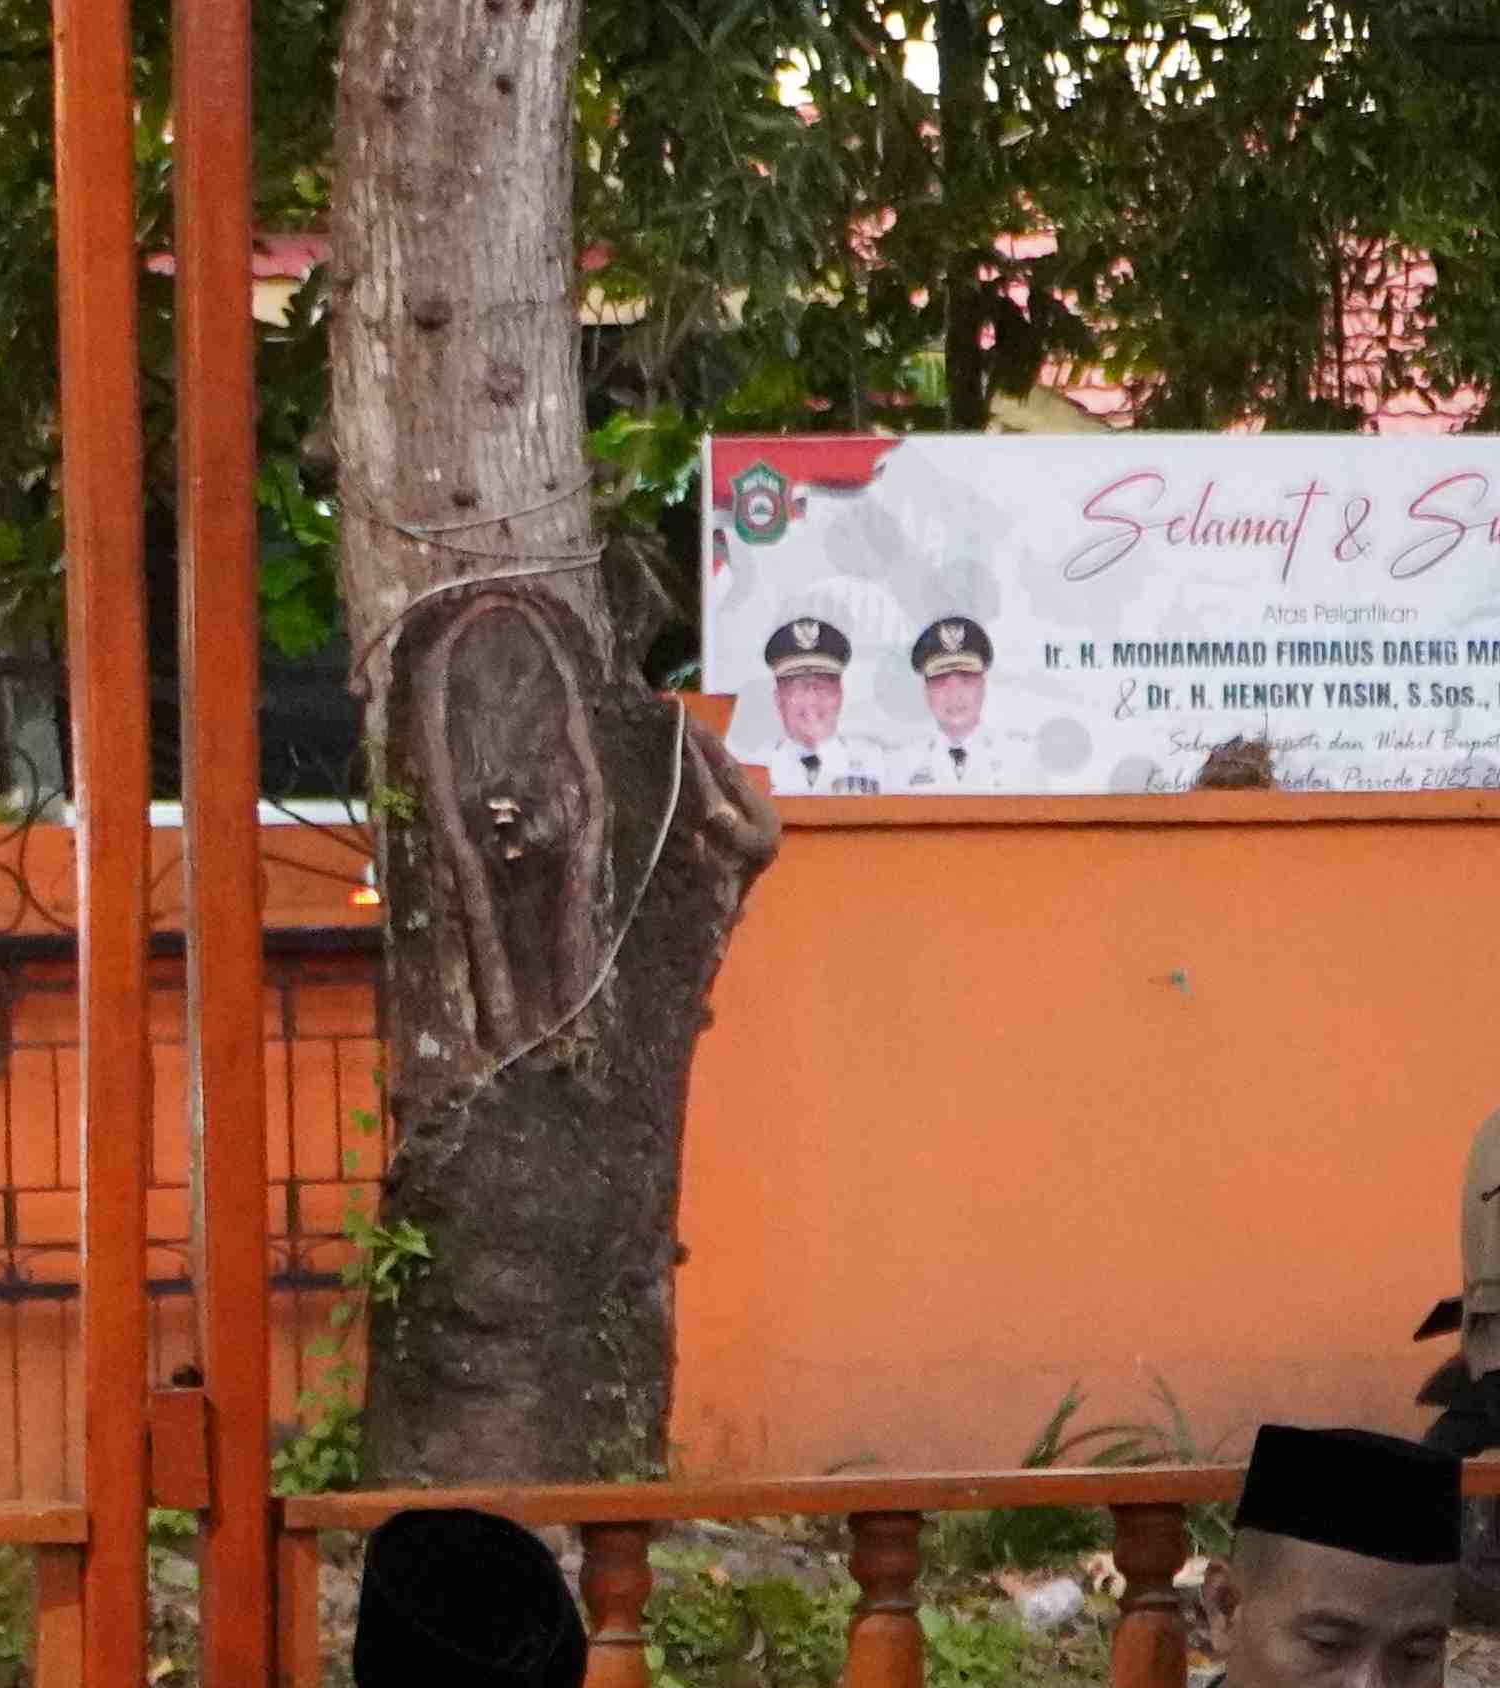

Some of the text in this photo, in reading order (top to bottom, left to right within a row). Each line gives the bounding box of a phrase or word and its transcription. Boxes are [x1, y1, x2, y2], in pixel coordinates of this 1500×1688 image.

[1063, 471, 1330, 583] Selamat
[1334, 496, 1371, 562] &
[1262, 603, 1419, 625] Atas Pelantikan
[1044, 641, 1072, 669] Ir.
[1080, 641, 1103, 669] H.
[1112, 641, 1268, 669] MOHAMMAD
[1276, 640, 1375, 668] FIRDAUS
[1382, 640, 1458, 667] DAENG
[1113, 677, 1137, 721] &
[1146, 683, 1182, 711] Dr.
[1190, 683, 1214, 710] H.
[1222, 683, 1315, 710] HENGKY
[1323, 682, 1400, 712] YASIN,
[1327, 728, 1365, 752] dan
